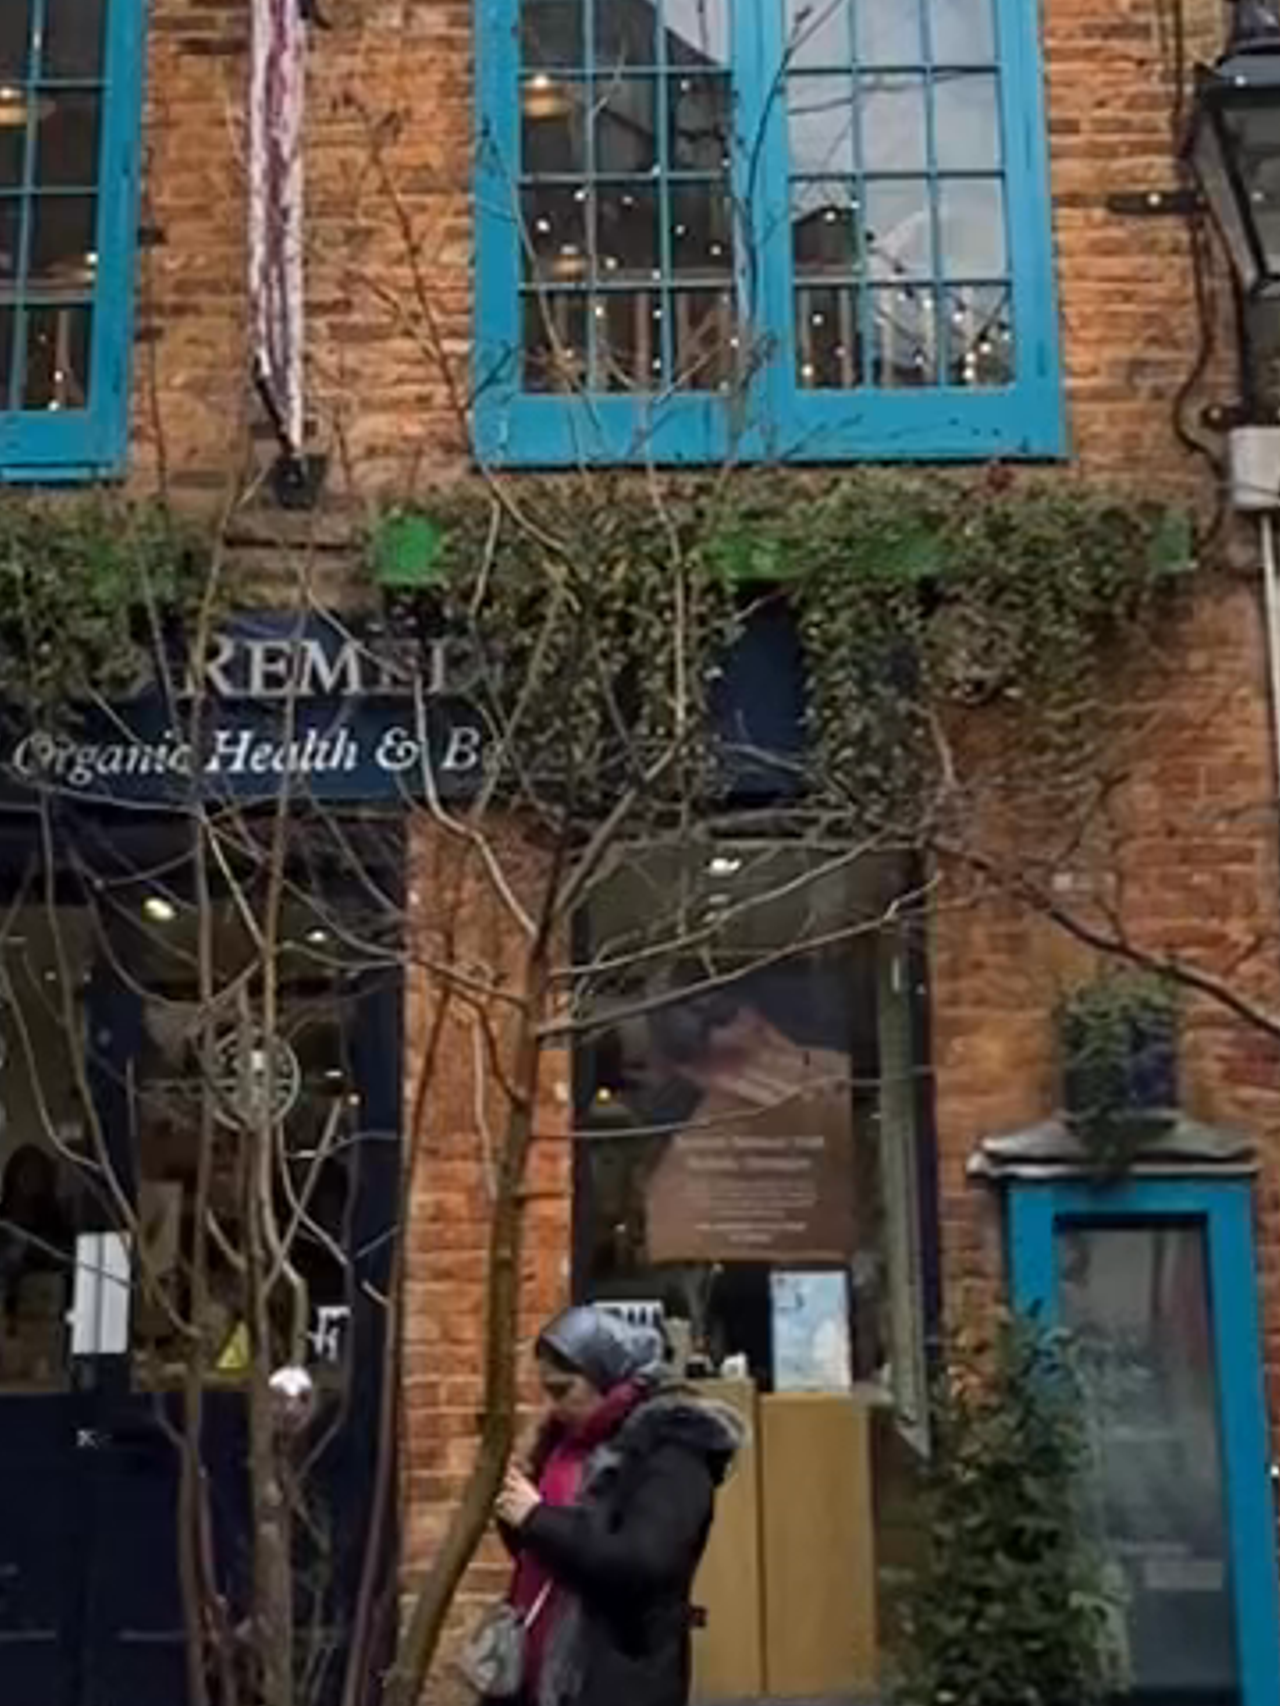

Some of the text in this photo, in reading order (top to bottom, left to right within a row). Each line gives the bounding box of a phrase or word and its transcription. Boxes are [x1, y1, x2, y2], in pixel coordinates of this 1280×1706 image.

[12, 731, 195, 786] Organic
[203, 727, 360, 773] Health
[374, 726, 420, 771] &
